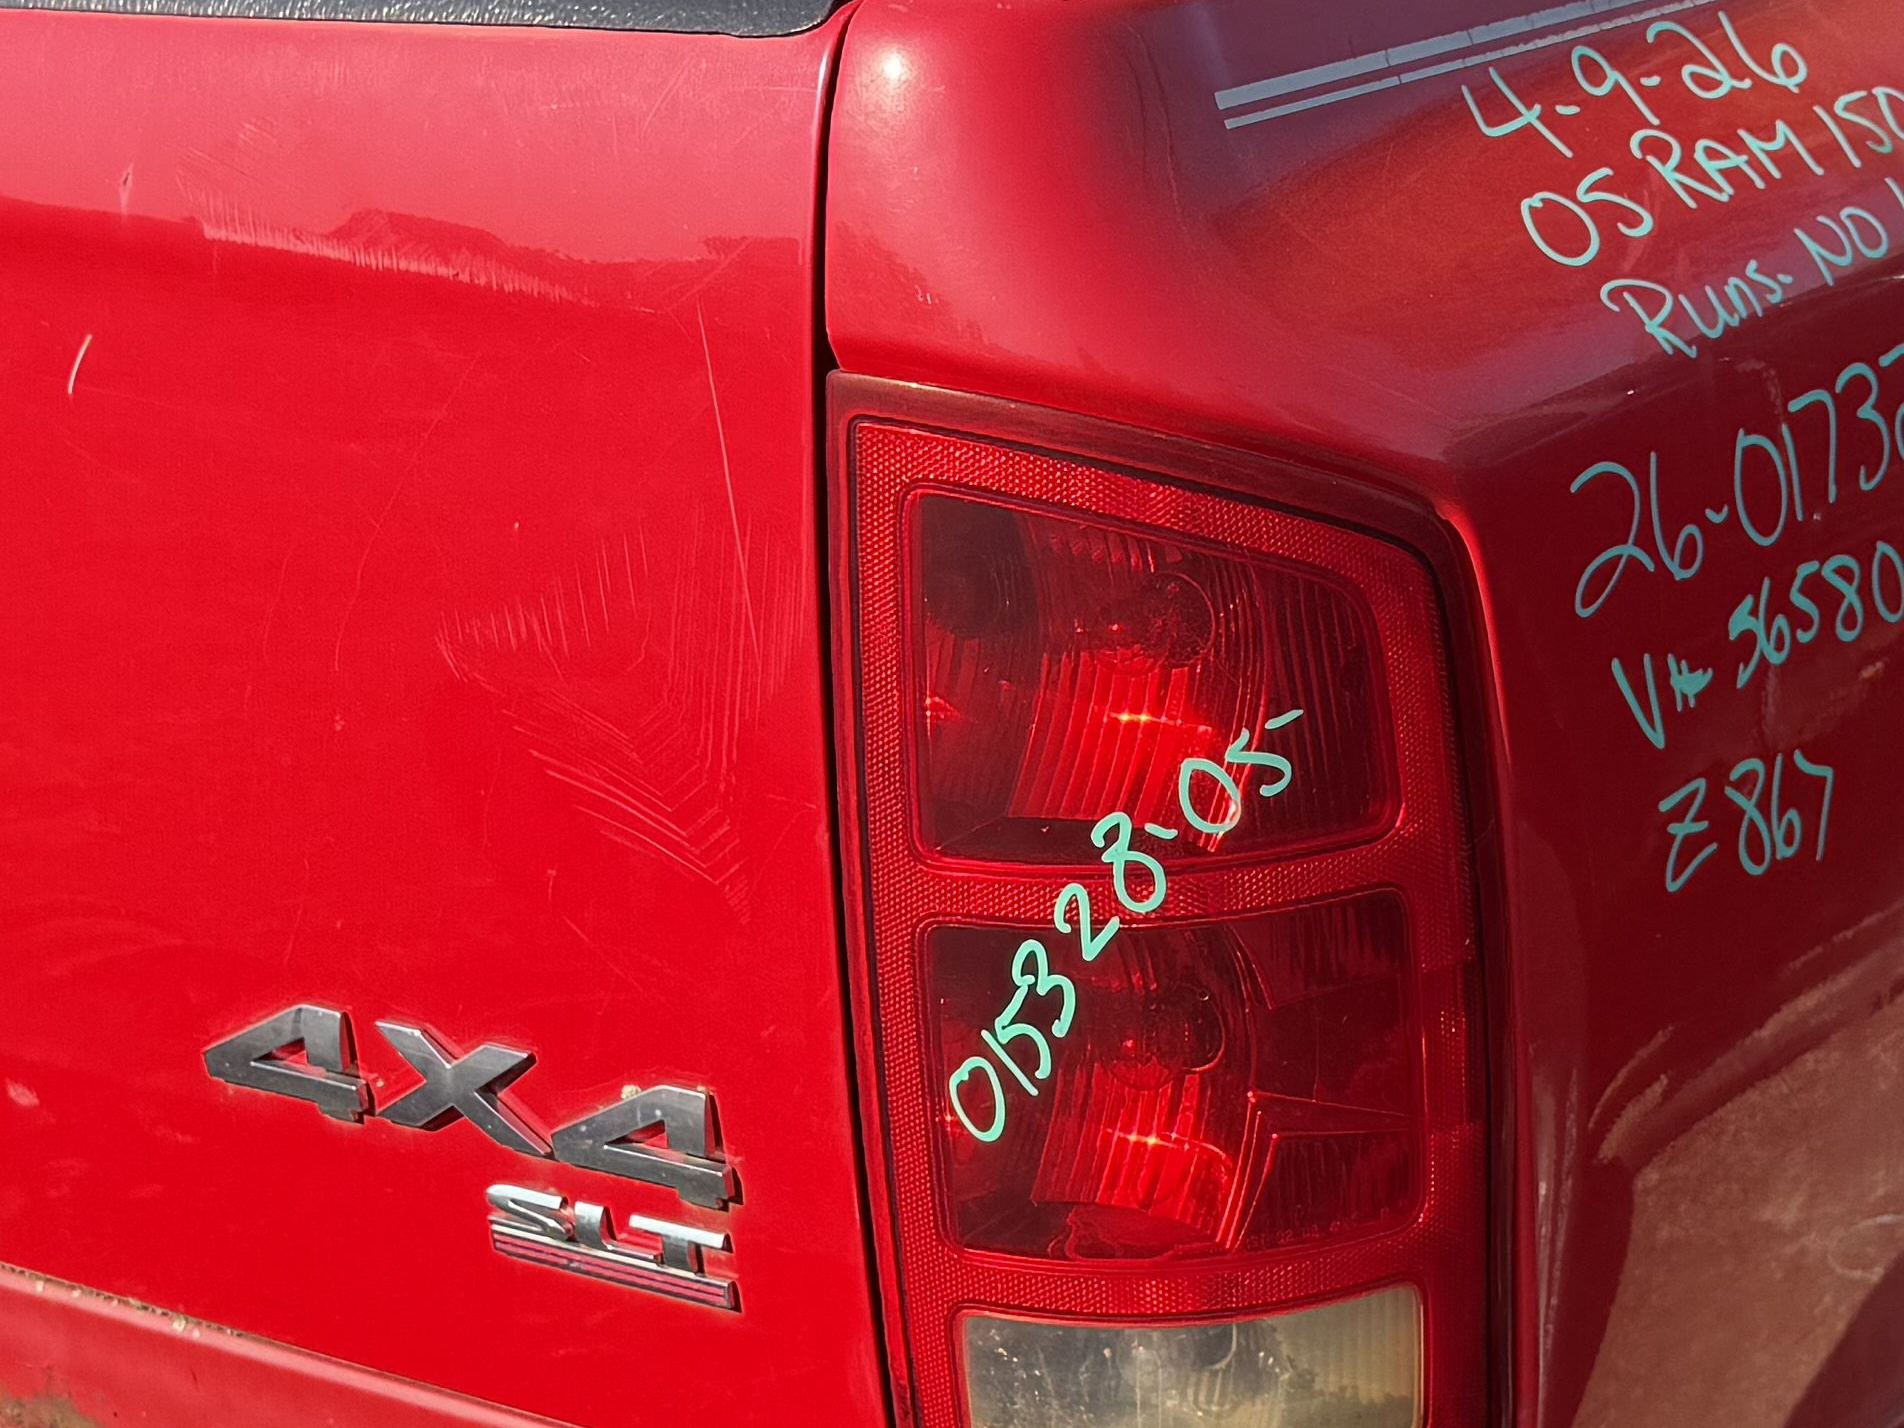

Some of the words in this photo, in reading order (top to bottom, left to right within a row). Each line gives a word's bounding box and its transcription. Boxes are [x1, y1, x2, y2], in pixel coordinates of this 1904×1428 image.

[1461, 11, 1808, 159] 4-9-26
[1629, 119, 1825, 209] RAM
[485, 1183, 733, 1277] SLT
